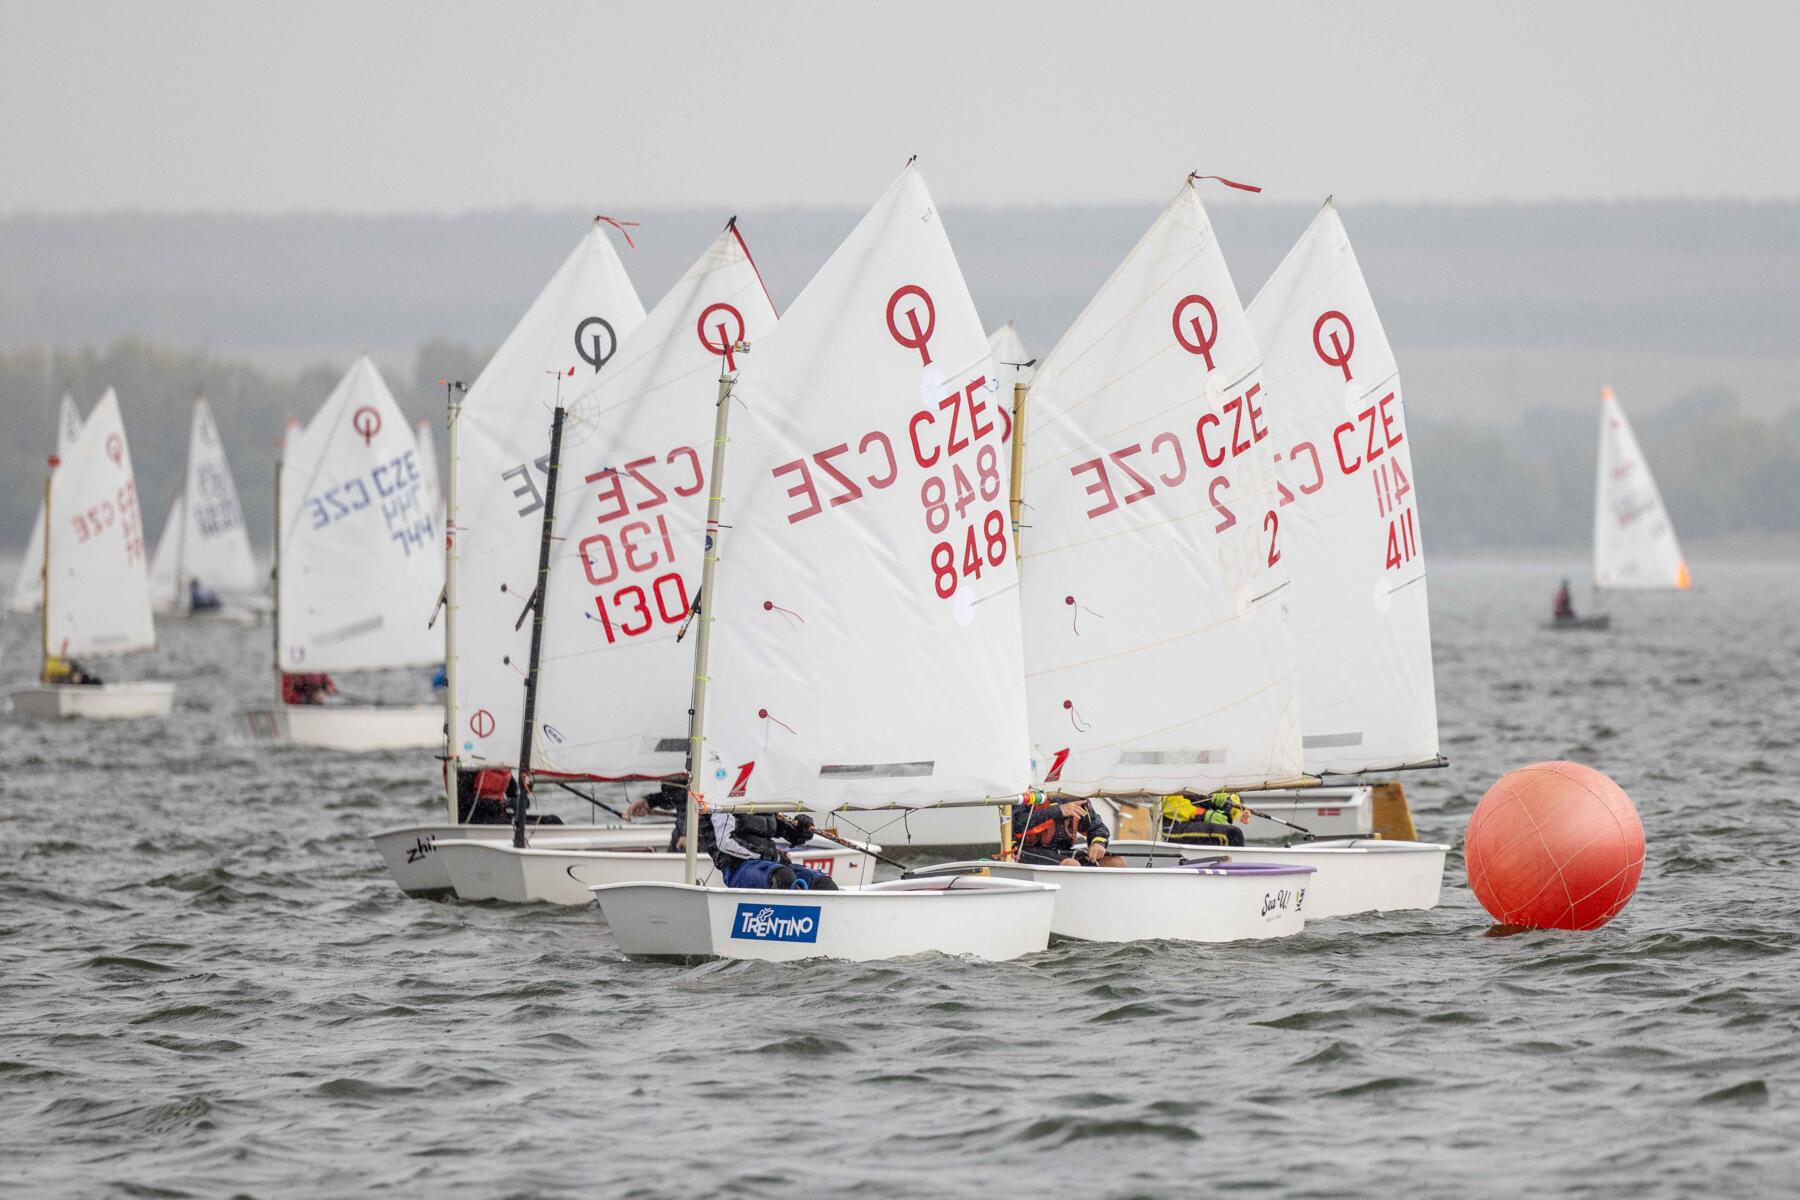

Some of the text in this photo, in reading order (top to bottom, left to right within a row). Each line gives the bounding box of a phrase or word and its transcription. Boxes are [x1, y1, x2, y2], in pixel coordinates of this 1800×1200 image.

[909, 375, 994, 468] CZE
[1196, 382, 1268, 468] CZE
[1333, 392, 1403, 475] CZE
[372, 450, 419, 497] CZE
[391, 514, 434, 558] 744
[931, 509, 1007, 599] 848
[1263, 510, 1281, 568] 2
[1386, 507, 1416, 570] 411
[595, 572, 690, 643] 130
[741, 911, 813, 938] TRENTINO
[1261, 893, 1276, 917] Sea
